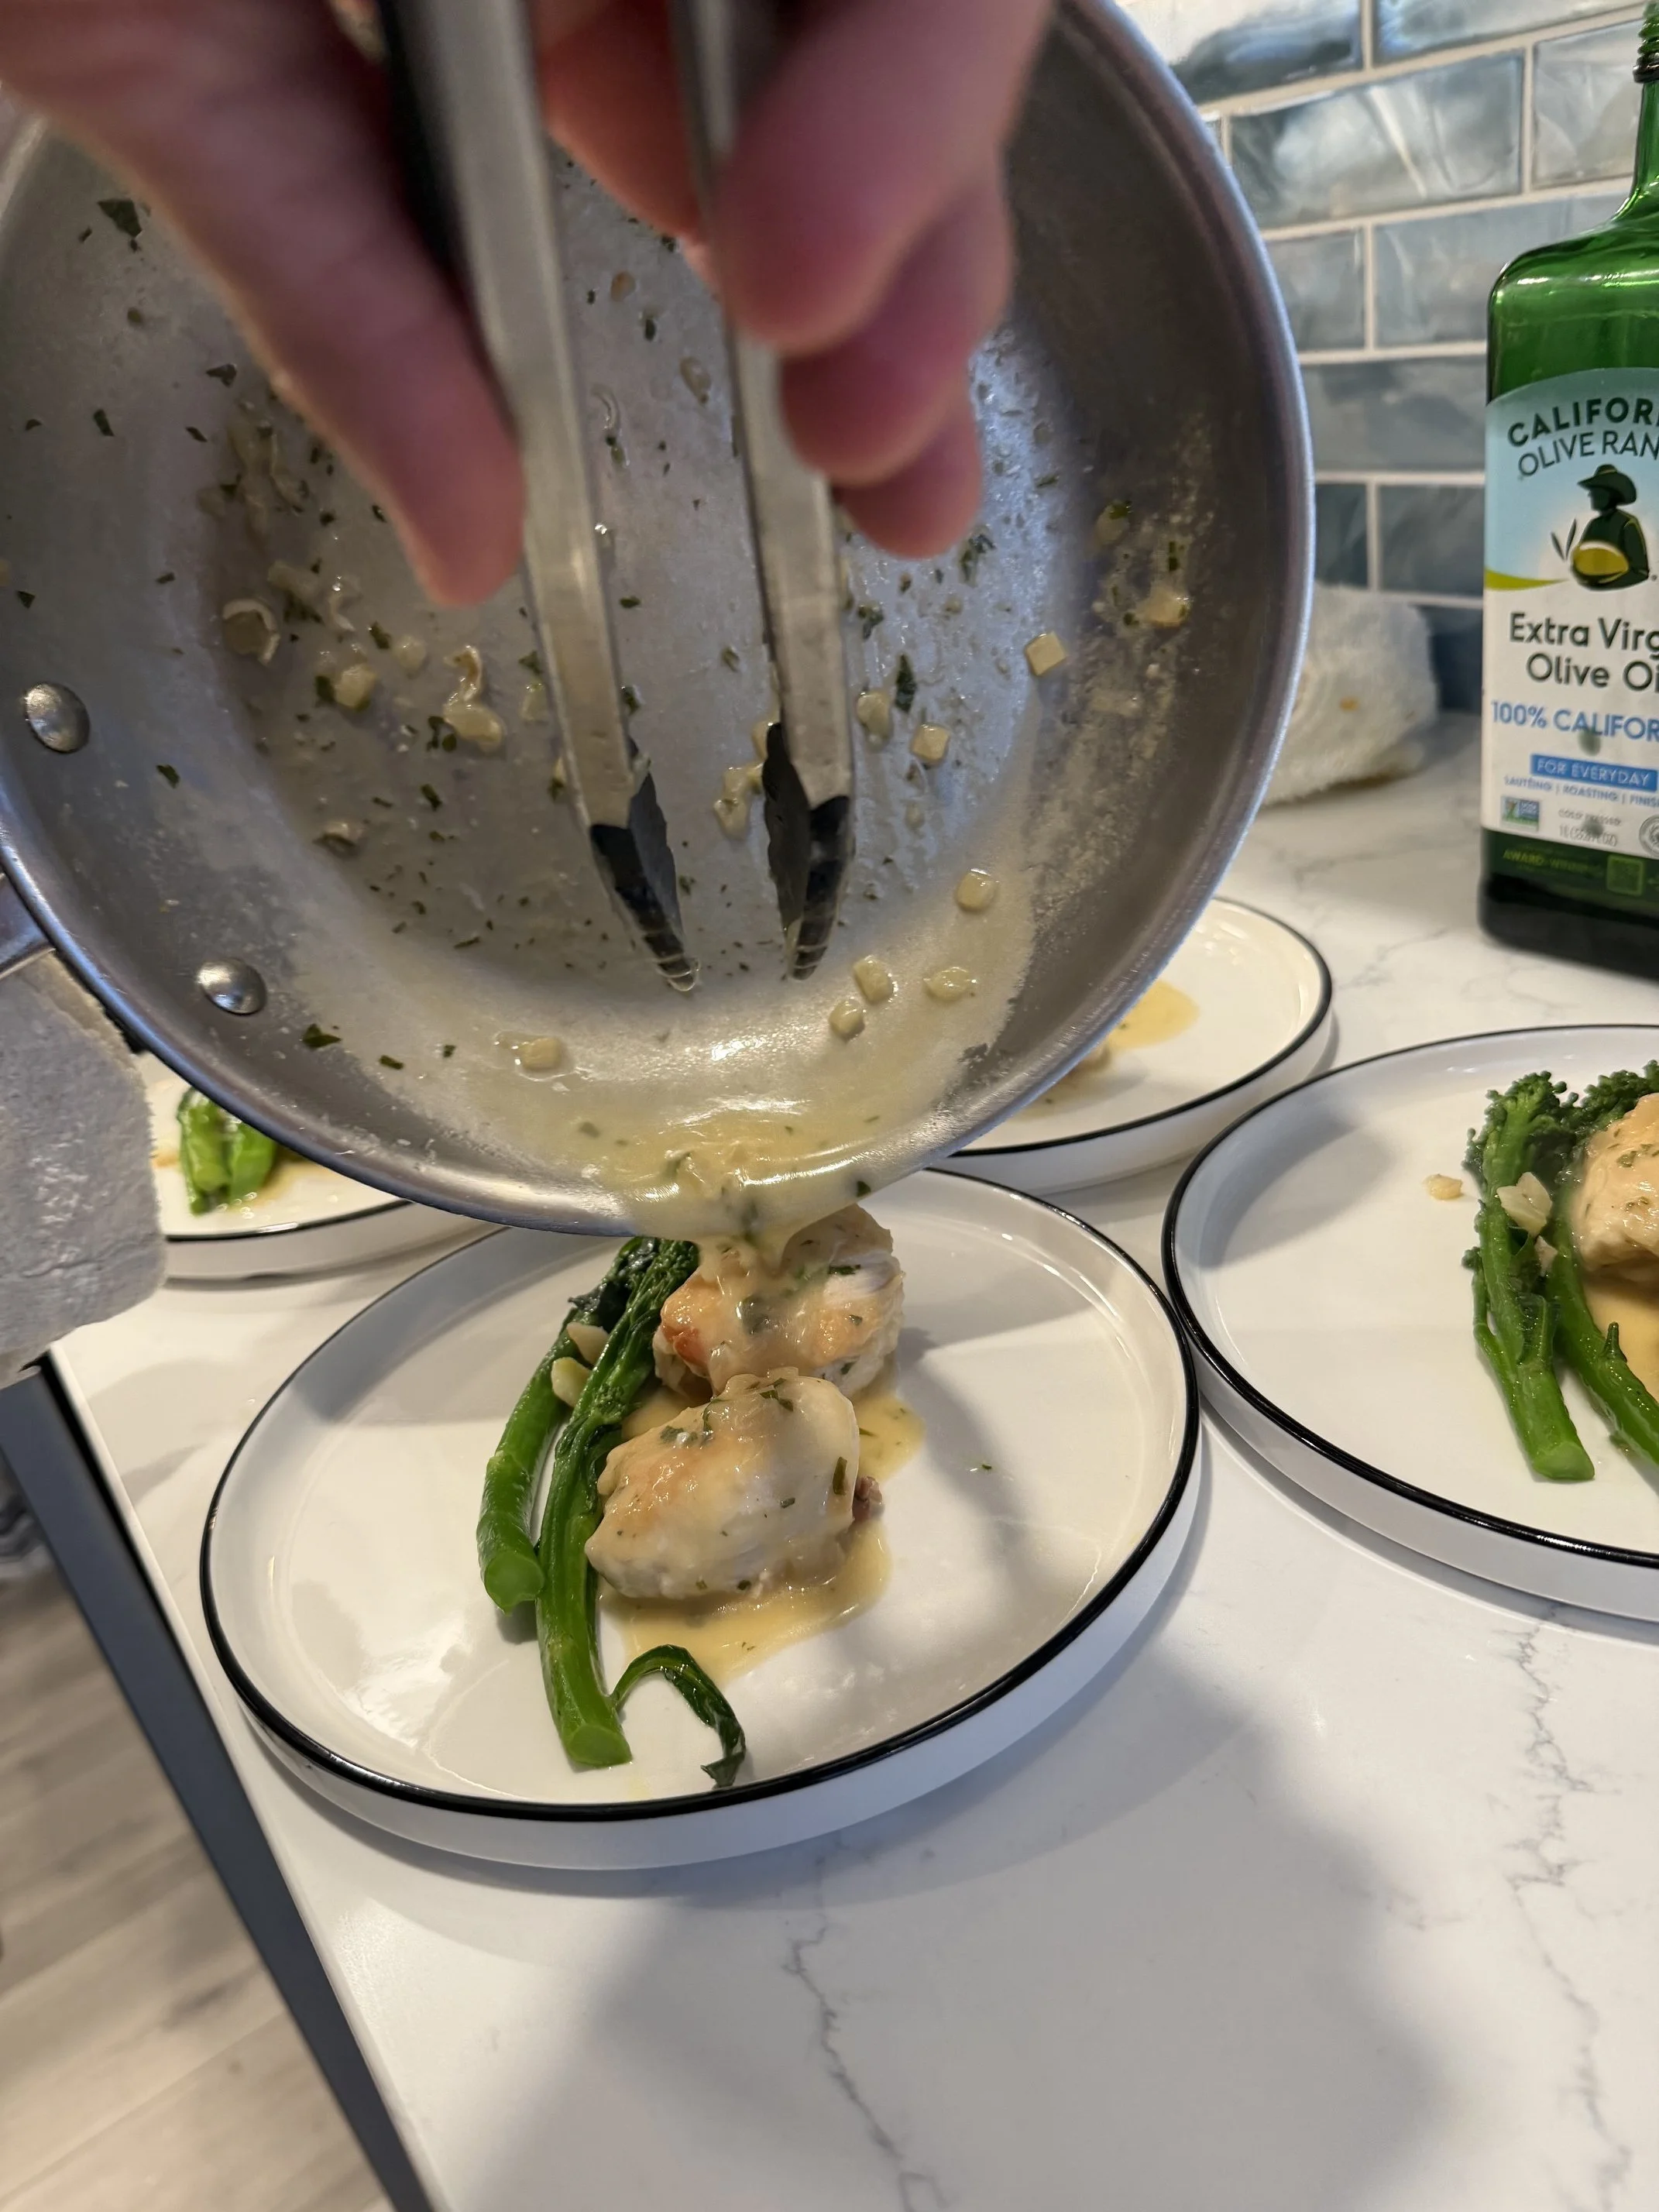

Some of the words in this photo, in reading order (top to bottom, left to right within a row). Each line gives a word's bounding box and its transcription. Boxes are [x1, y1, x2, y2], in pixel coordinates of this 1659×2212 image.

[1507, 397, 1659, 447] CALIFOR
[1518, 431, 1595, 476] OLIVE
[1602, 430, 1659, 461] RAN
[1510, 612, 1589, 647] Extra
[1598, 617, 1659, 661] Virg
[1526, 652, 1610, 689] Olive
[1491, 700, 1548, 729] 100%
[1536, 757, 1567, 775] FOR
[1571, 761, 1650, 787] EVERYDAY
[1562, 785, 1619, 802] ROASTING
[1630, 794, 1659, 808] FINIS
